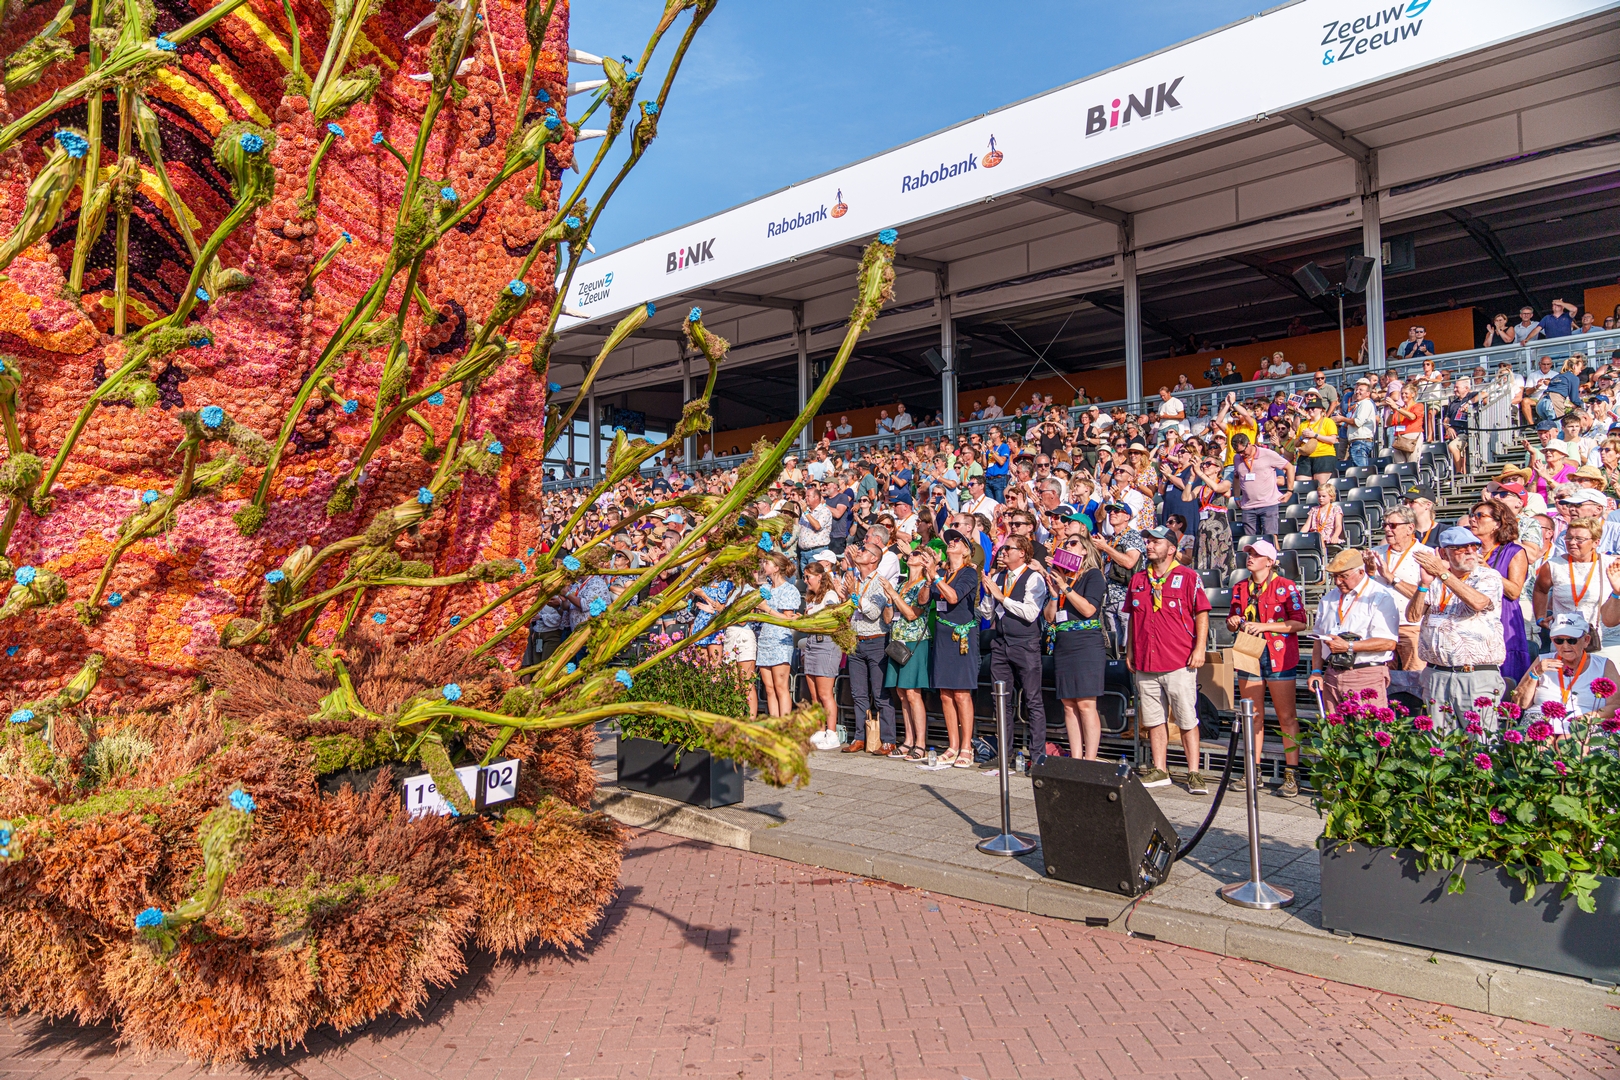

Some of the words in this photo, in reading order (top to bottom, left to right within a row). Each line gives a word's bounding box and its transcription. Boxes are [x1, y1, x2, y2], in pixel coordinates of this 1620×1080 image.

[1321, 3, 1404, 46] Zeeuw
[902, 153, 978, 194] Rabobank
[767, 205, 828, 238] Rabobank
[578, 278, 605, 295] Zeeuw
[489, 766, 513, 789] 02
